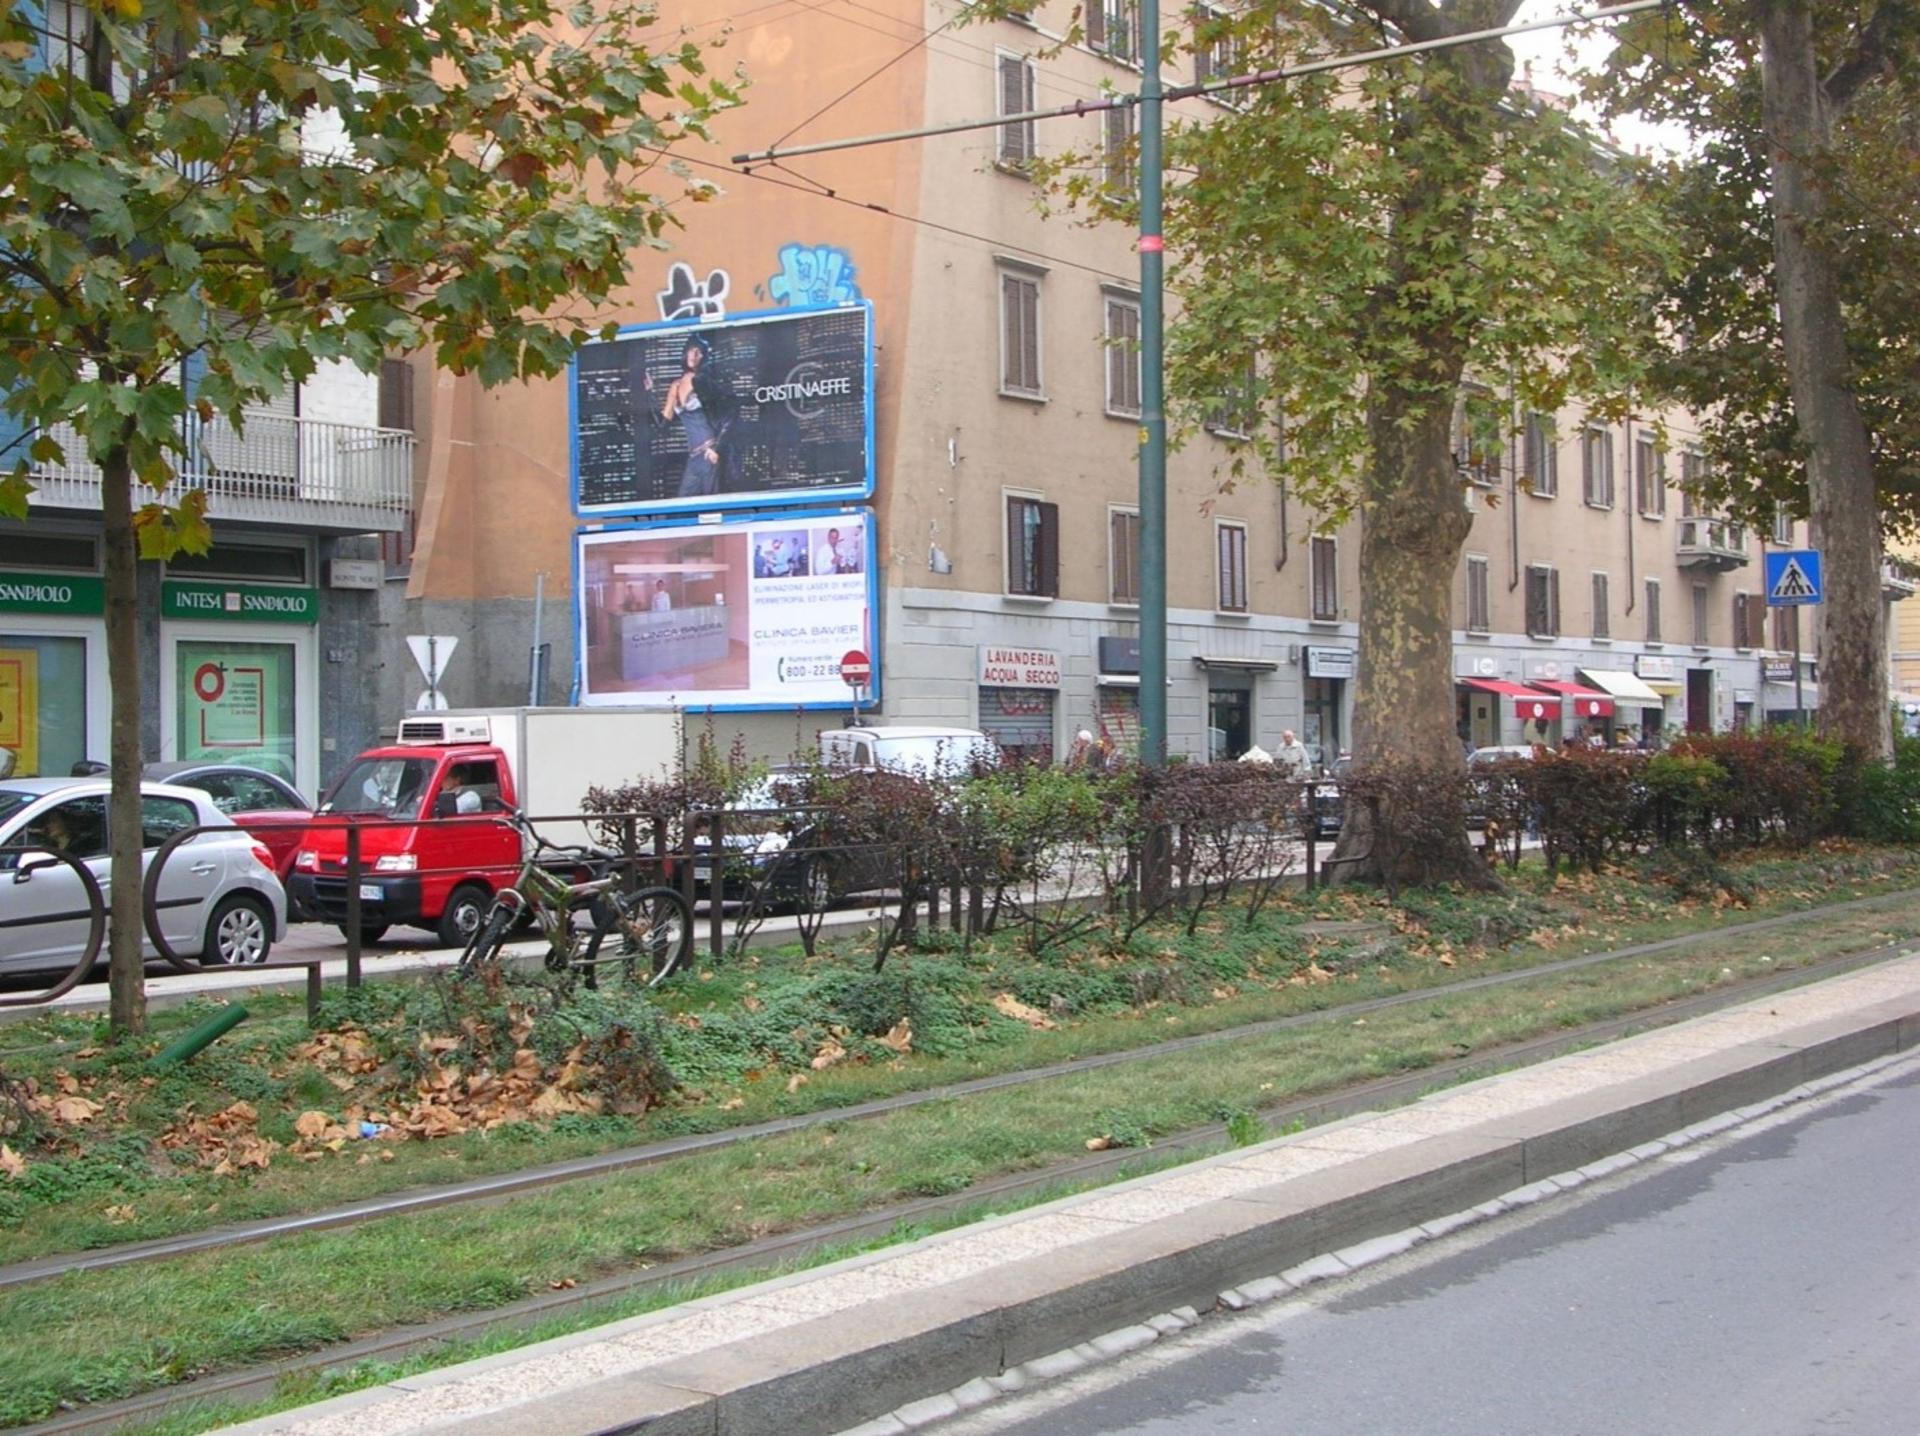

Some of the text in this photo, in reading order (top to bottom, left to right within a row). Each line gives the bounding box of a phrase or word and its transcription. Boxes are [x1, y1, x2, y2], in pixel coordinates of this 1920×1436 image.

[755, 377, 851, 403] CRISTINAEFFE
[0, 583, 72, 603] SANPAOLO
[176, 591, 308, 613] INTESA SANPAOLO
[753, 628, 808, 640] CLINICA
[987, 649, 1056, 667] LAVANDERIA
[984, 667, 1060, 685] ACQUA SECCO
